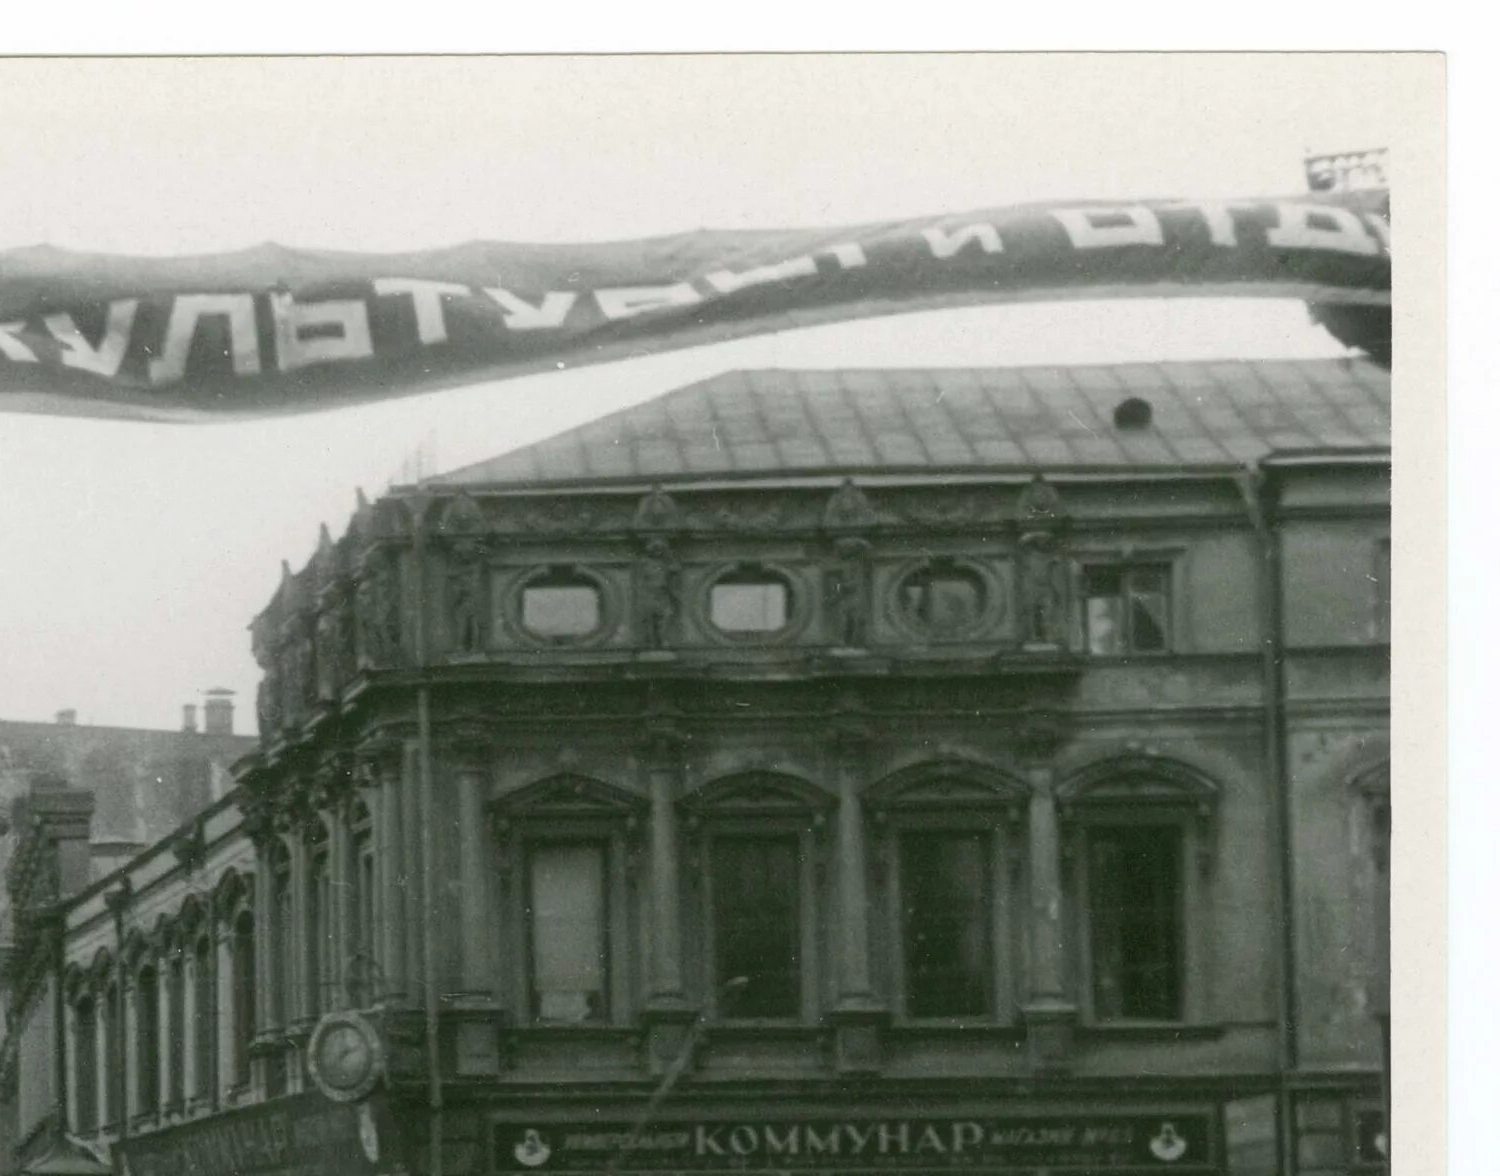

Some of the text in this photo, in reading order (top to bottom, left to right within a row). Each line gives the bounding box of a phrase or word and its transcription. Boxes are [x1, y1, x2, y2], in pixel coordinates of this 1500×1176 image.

[920, 222, 1003, 258] И
[1053, 202, 1391, 257] ОТД
[694, 1121, 986, 1156] КОММУНАР
